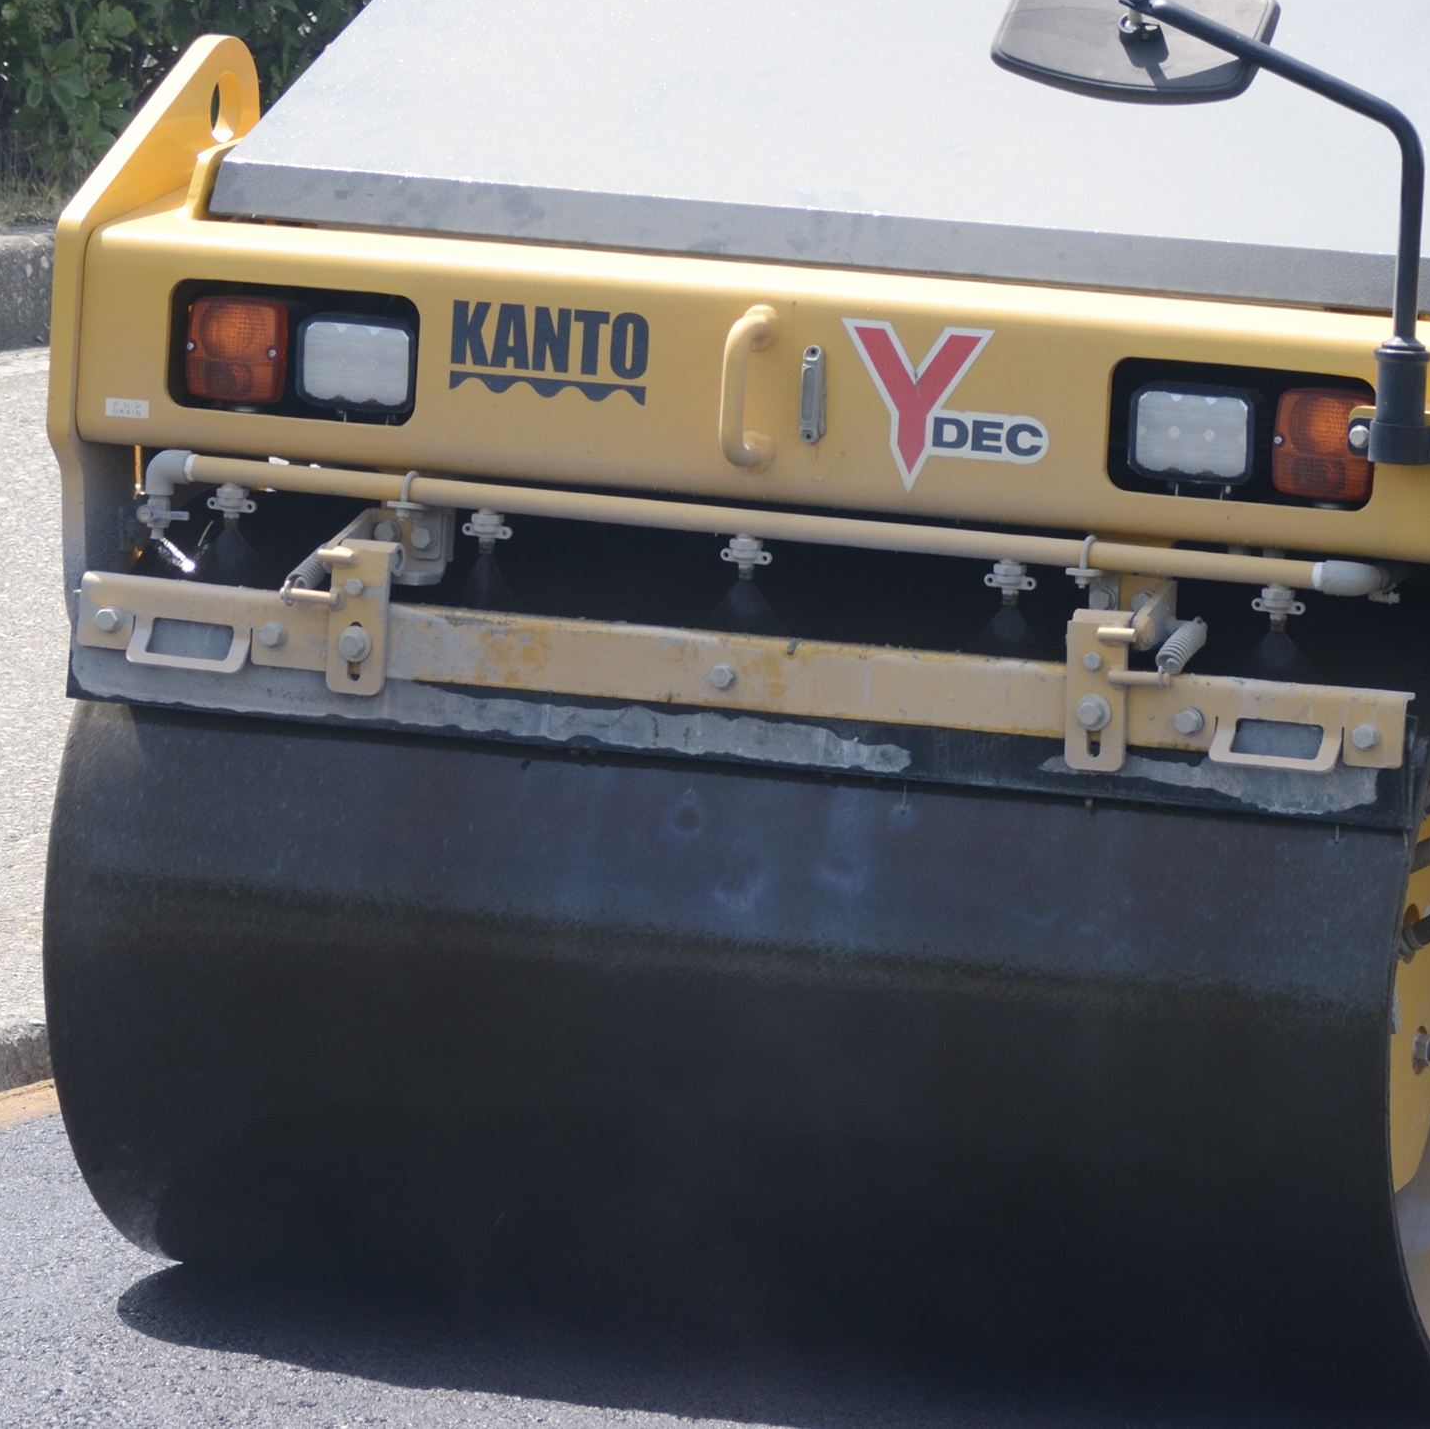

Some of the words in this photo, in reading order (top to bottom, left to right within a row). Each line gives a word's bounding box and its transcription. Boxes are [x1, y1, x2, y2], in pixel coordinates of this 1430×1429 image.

[449, 299, 650, 380] KANTO
[112, 408, 141, 417] DRAIN
[113, 400, 141, 409] ドレン
[932, 416, 1044, 457] DEC
